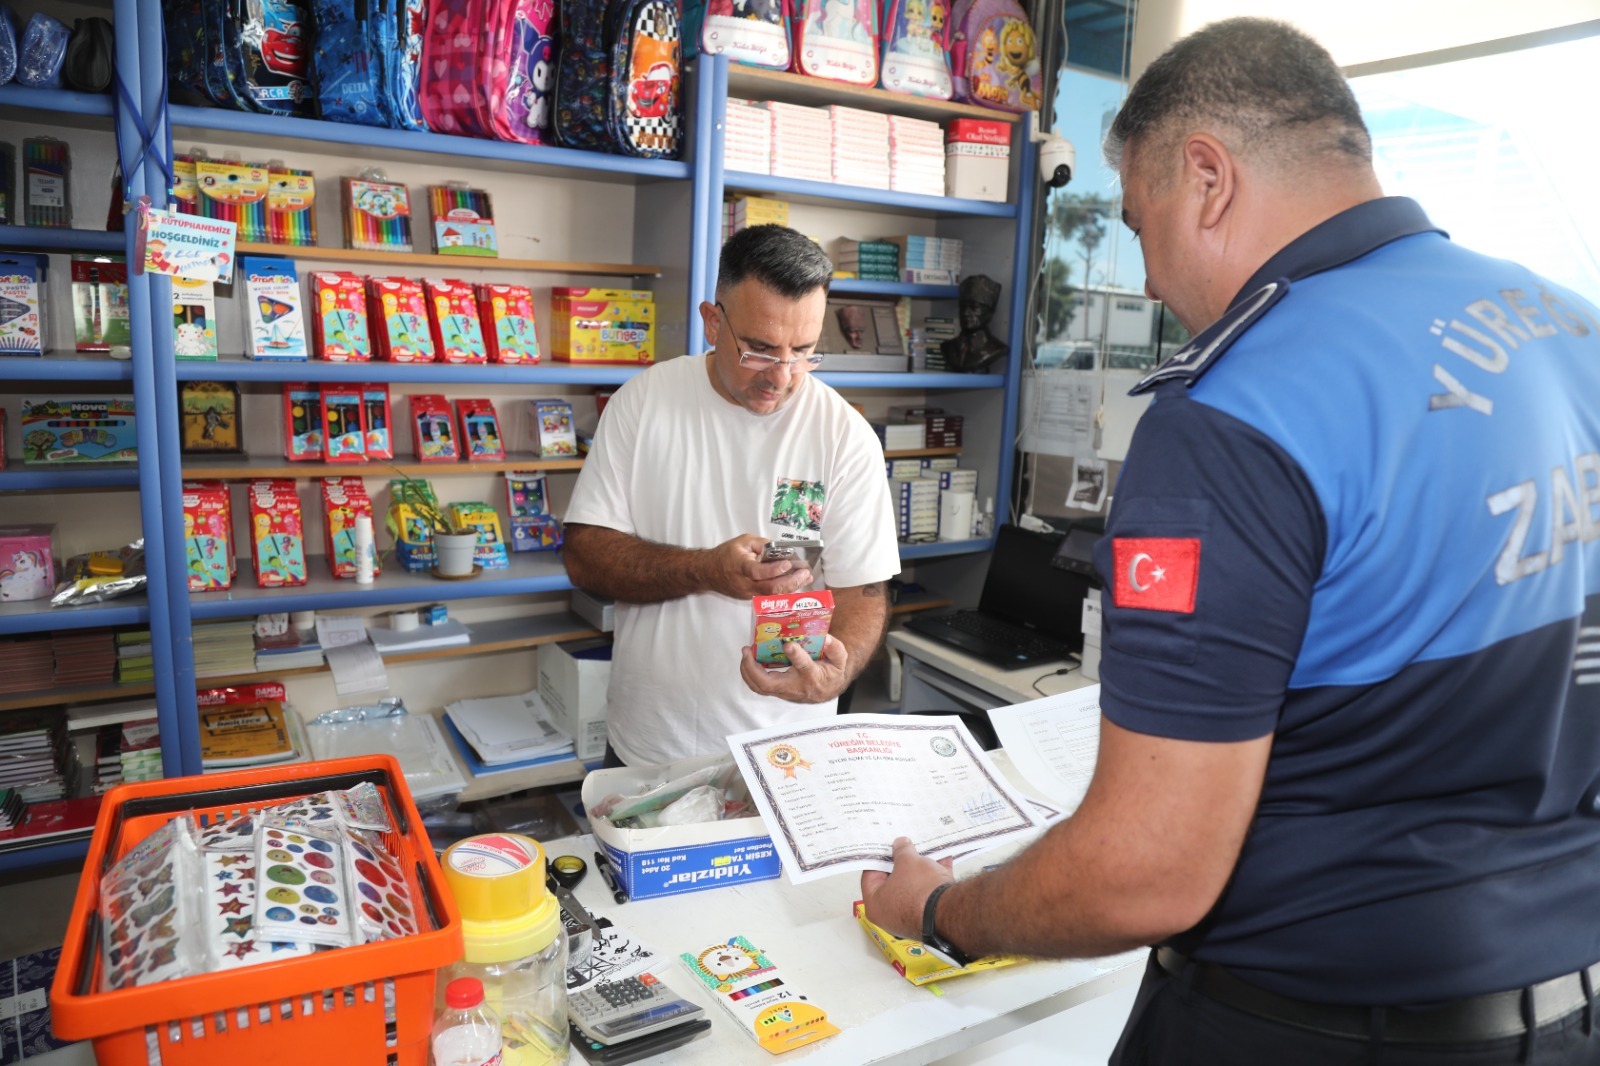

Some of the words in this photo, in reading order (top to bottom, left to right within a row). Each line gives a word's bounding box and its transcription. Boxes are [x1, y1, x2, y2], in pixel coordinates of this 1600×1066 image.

[341, 82, 369, 94] DELTA
[160, 216, 231, 235] KÜTÜPHANEMİZE
[151, 230, 220, 248] HOŞGELDİNİZ
[71, 403, 107, 411] Nova
[514, 526, 525, 540] 6
[256, 686, 284, 697] DAMLA
[828, 739, 865, 749] YÜREĞİR
[867, 740, 902, 748] BELEDİYE
[846, 746, 894, 754] BAŞKANLIĞI
[733, 846, 746, 854] Set
[749, 842, 773, 852] Fraction
[672, 854, 686, 862] Kod
[744, 849, 773, 861] KESİR
[641, 858, 655, 867] 118
[641, 866, 659, 874] Adet
[660, 864, 671, 872] 20
[672, 864, 752, 884] Yıldızlar
[777, 990, 792, 1000] 12
[769, 1005, 788, 1014] ADEL
